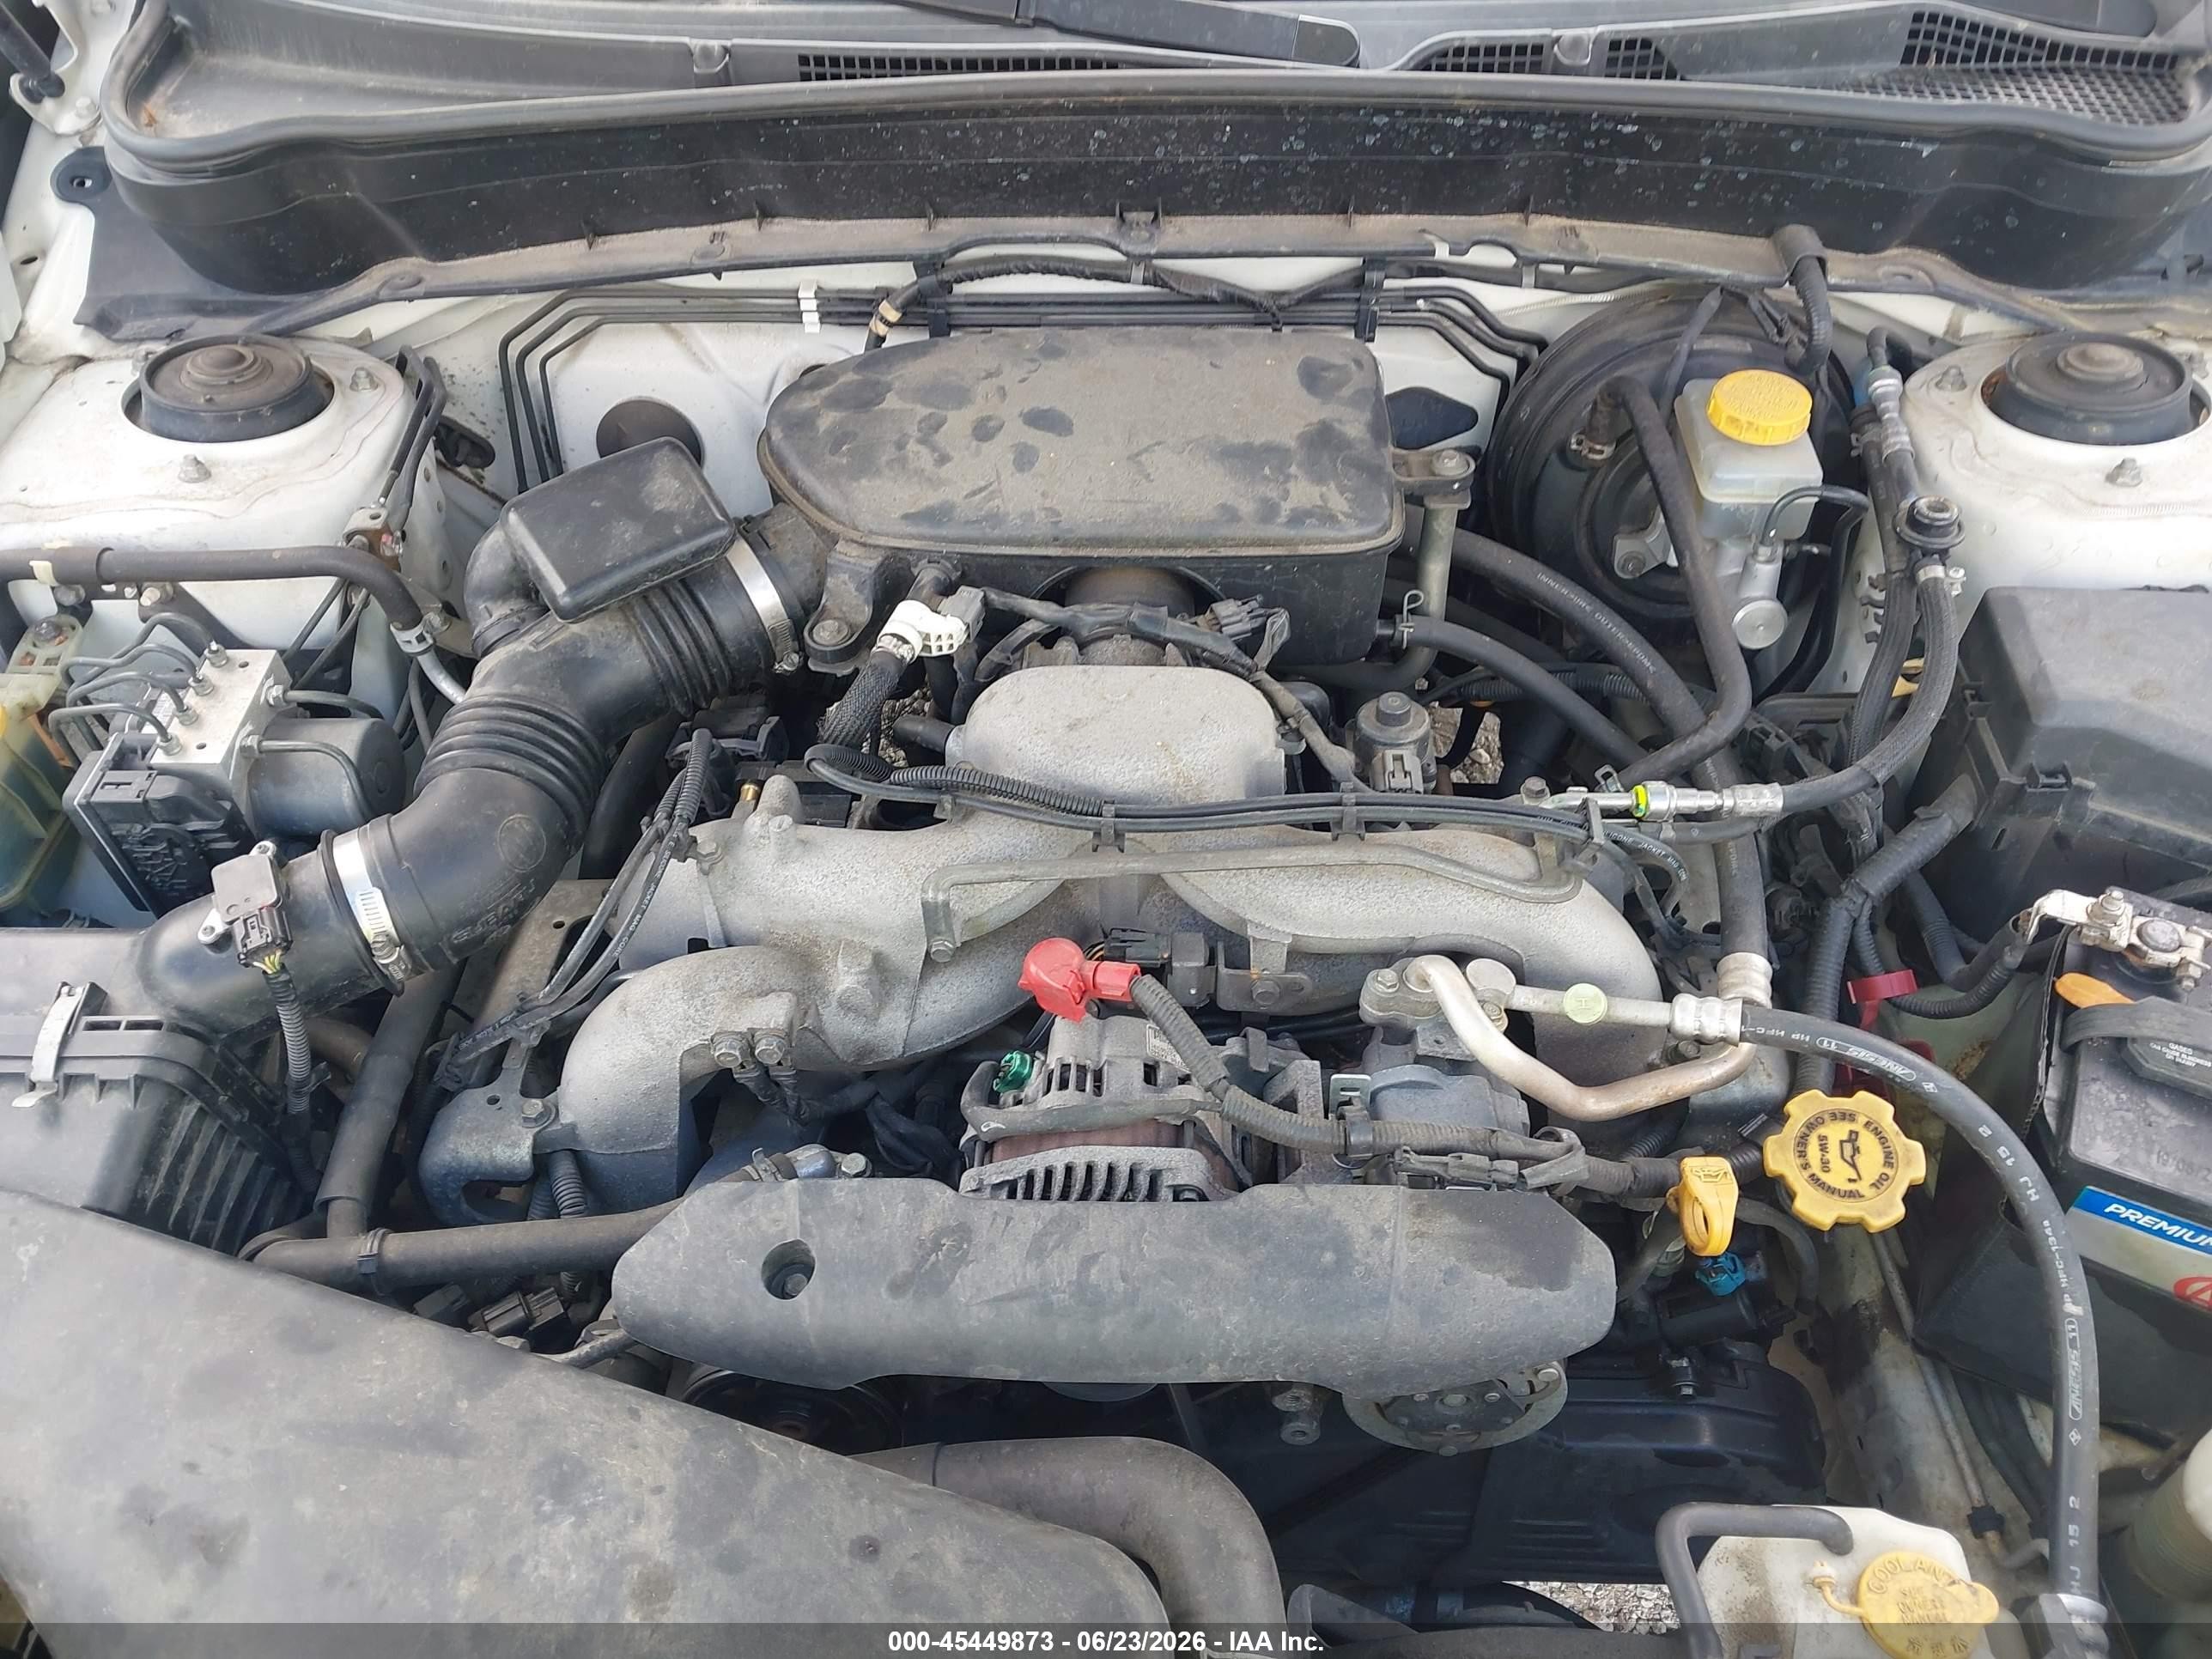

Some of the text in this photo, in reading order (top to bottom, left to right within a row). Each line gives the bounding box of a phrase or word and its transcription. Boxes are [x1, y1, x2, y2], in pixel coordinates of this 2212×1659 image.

[641, 883, 656, 911] JACKET
[629, 914, 642, 931] MAG
[1790, 1032, 1810, 1042] HP
[1978, 1124, 1993, 1138] 2
[1796, 1111, 1865, 1199] SEE OWNER'S MANUAL
[1863, 1120, 1894, 1190] ENGINE OIL
[2069, 1495, 2081, 1510] 2
[2069, 1524, 2079, 1547] 15
